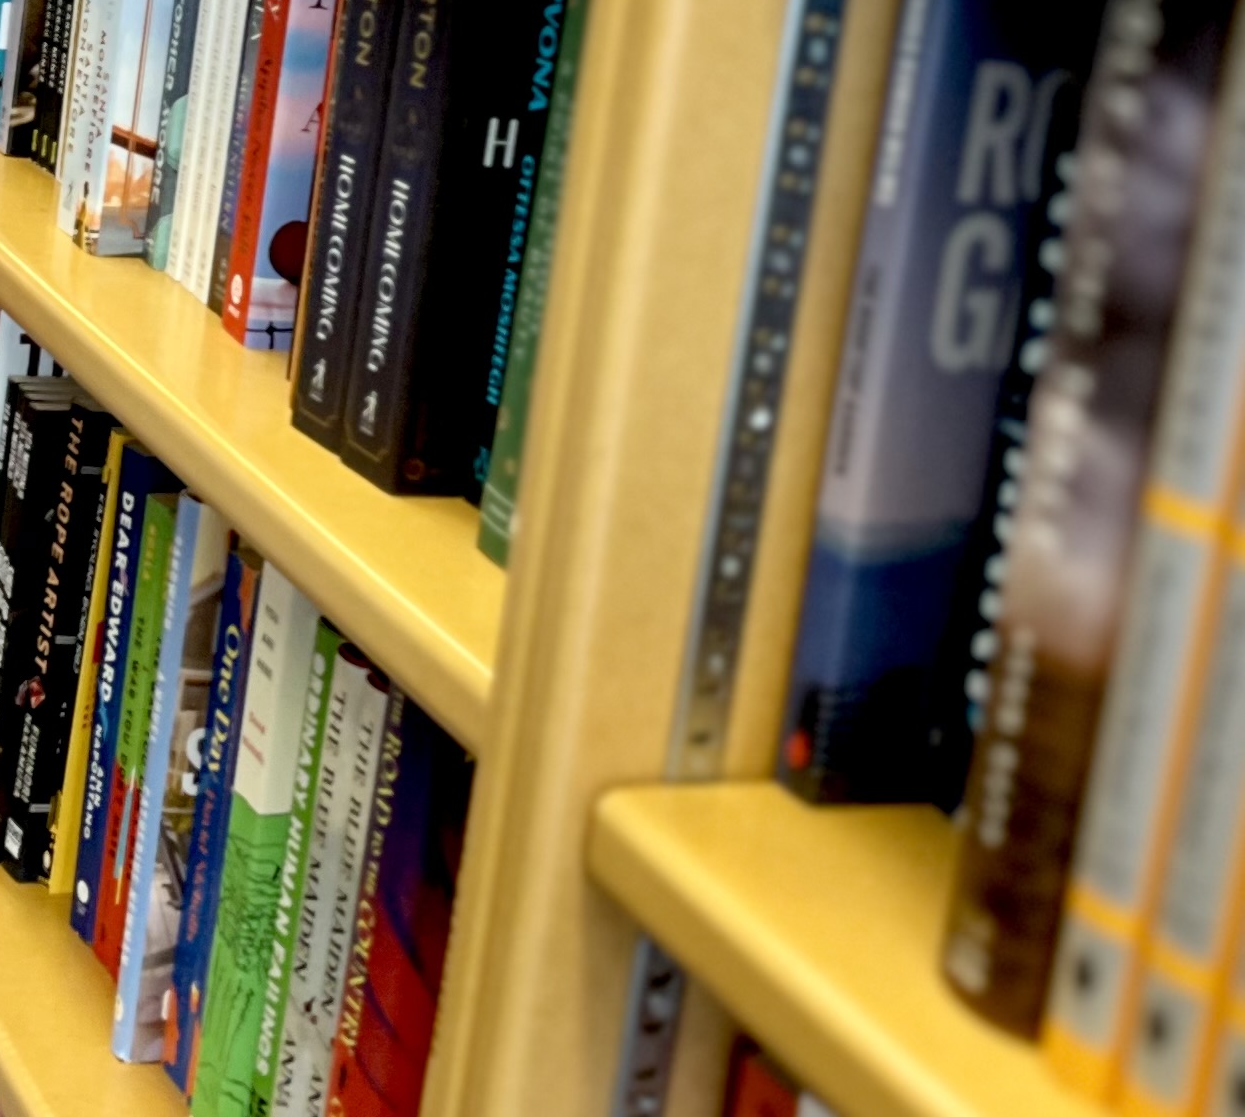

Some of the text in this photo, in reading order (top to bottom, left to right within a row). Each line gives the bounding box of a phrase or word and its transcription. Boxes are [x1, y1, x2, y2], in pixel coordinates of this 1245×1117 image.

[77, 43, 93, 117] SANTA
[84, 30, 107, 173] MONTEFIORE
[94, 72, 110, 139] SANTA
[316, 153, 356, 341] HOMECOMING
[367, 179, 410, 373] HOMECOMING
[34, 417, 84, 674] THE ROPE ARTIST
[99, 492, 134, 703] DEAR EDWARD
[82, 723, 102, 841] NAPOLITANO
[207, 623, 240, 782] One Day
[376, 737, 403, 824] ROAD
[257, 651, 327, 1079] ORDINARY HUMAN FAILINGS
[274, 690, 348, 1114] THE BLUE MAIDEN ANNA
[308, 719, 375, 1117] THE BLUE MAIDEN ANN
[339, 900, 374, 1054] COUNTRY
